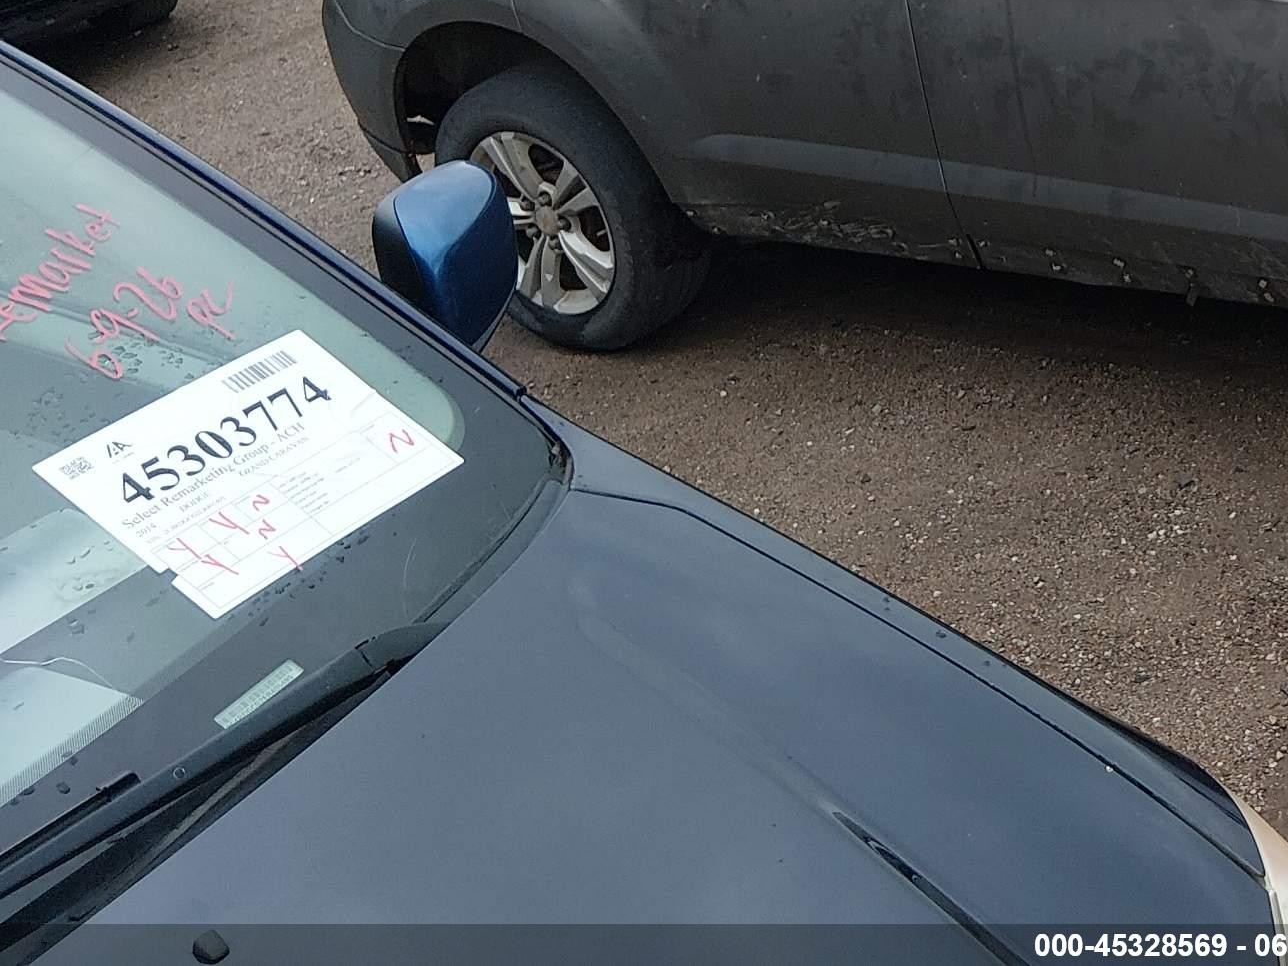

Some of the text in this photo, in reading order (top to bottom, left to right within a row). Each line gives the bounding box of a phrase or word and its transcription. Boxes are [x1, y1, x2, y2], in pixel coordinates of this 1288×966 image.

[121, 375, 333, 504] 45303774
[121, 502, 162, 531] Select
[159, 458, 237, 509] Remarketing
[232, 442, 271, 468] Group
[277, 421, 306, 443] ACH
